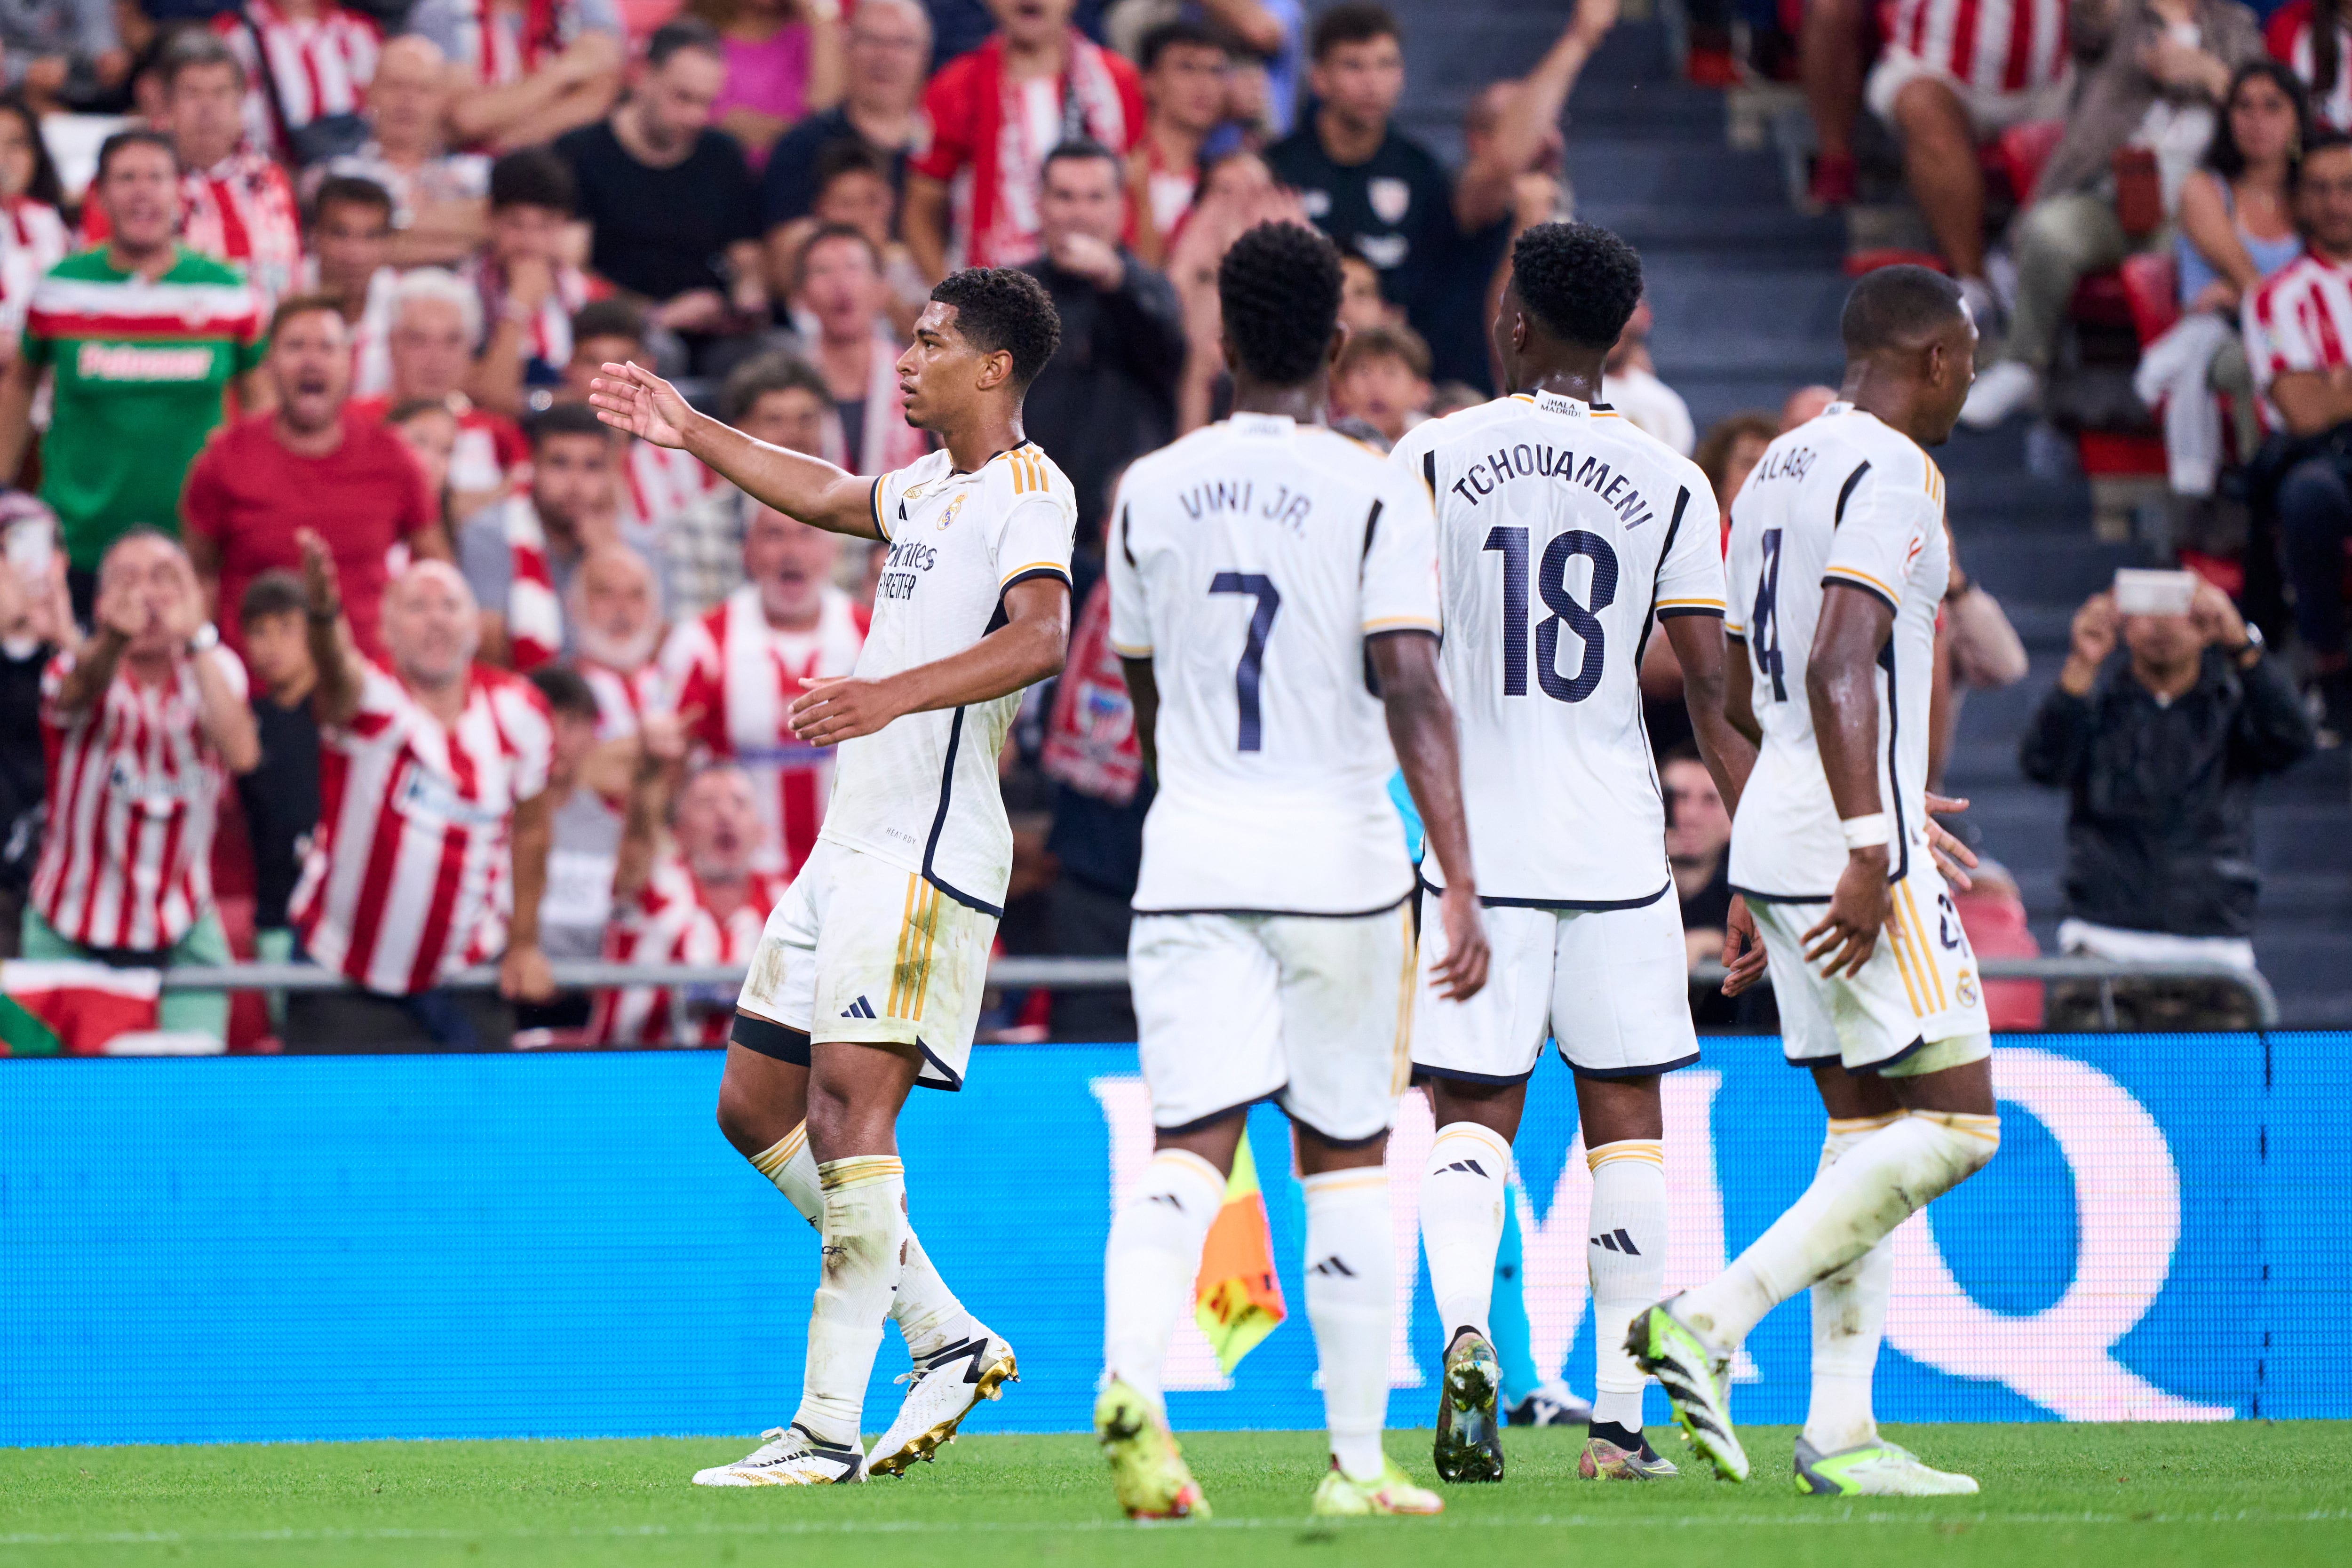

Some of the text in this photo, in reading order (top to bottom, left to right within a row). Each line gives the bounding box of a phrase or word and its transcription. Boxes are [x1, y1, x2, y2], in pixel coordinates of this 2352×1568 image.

[1541, 404, 1581, 418] MADRID!
[1180, 481, 1311, 540] VINI JR.
[1451, 444, 1653, 532] TCHOUAMENI
[1208, 571, 1281, 752] 7
[1483, 525, 1619, 703] 18
[1753, 528, 1788, 702] 4
